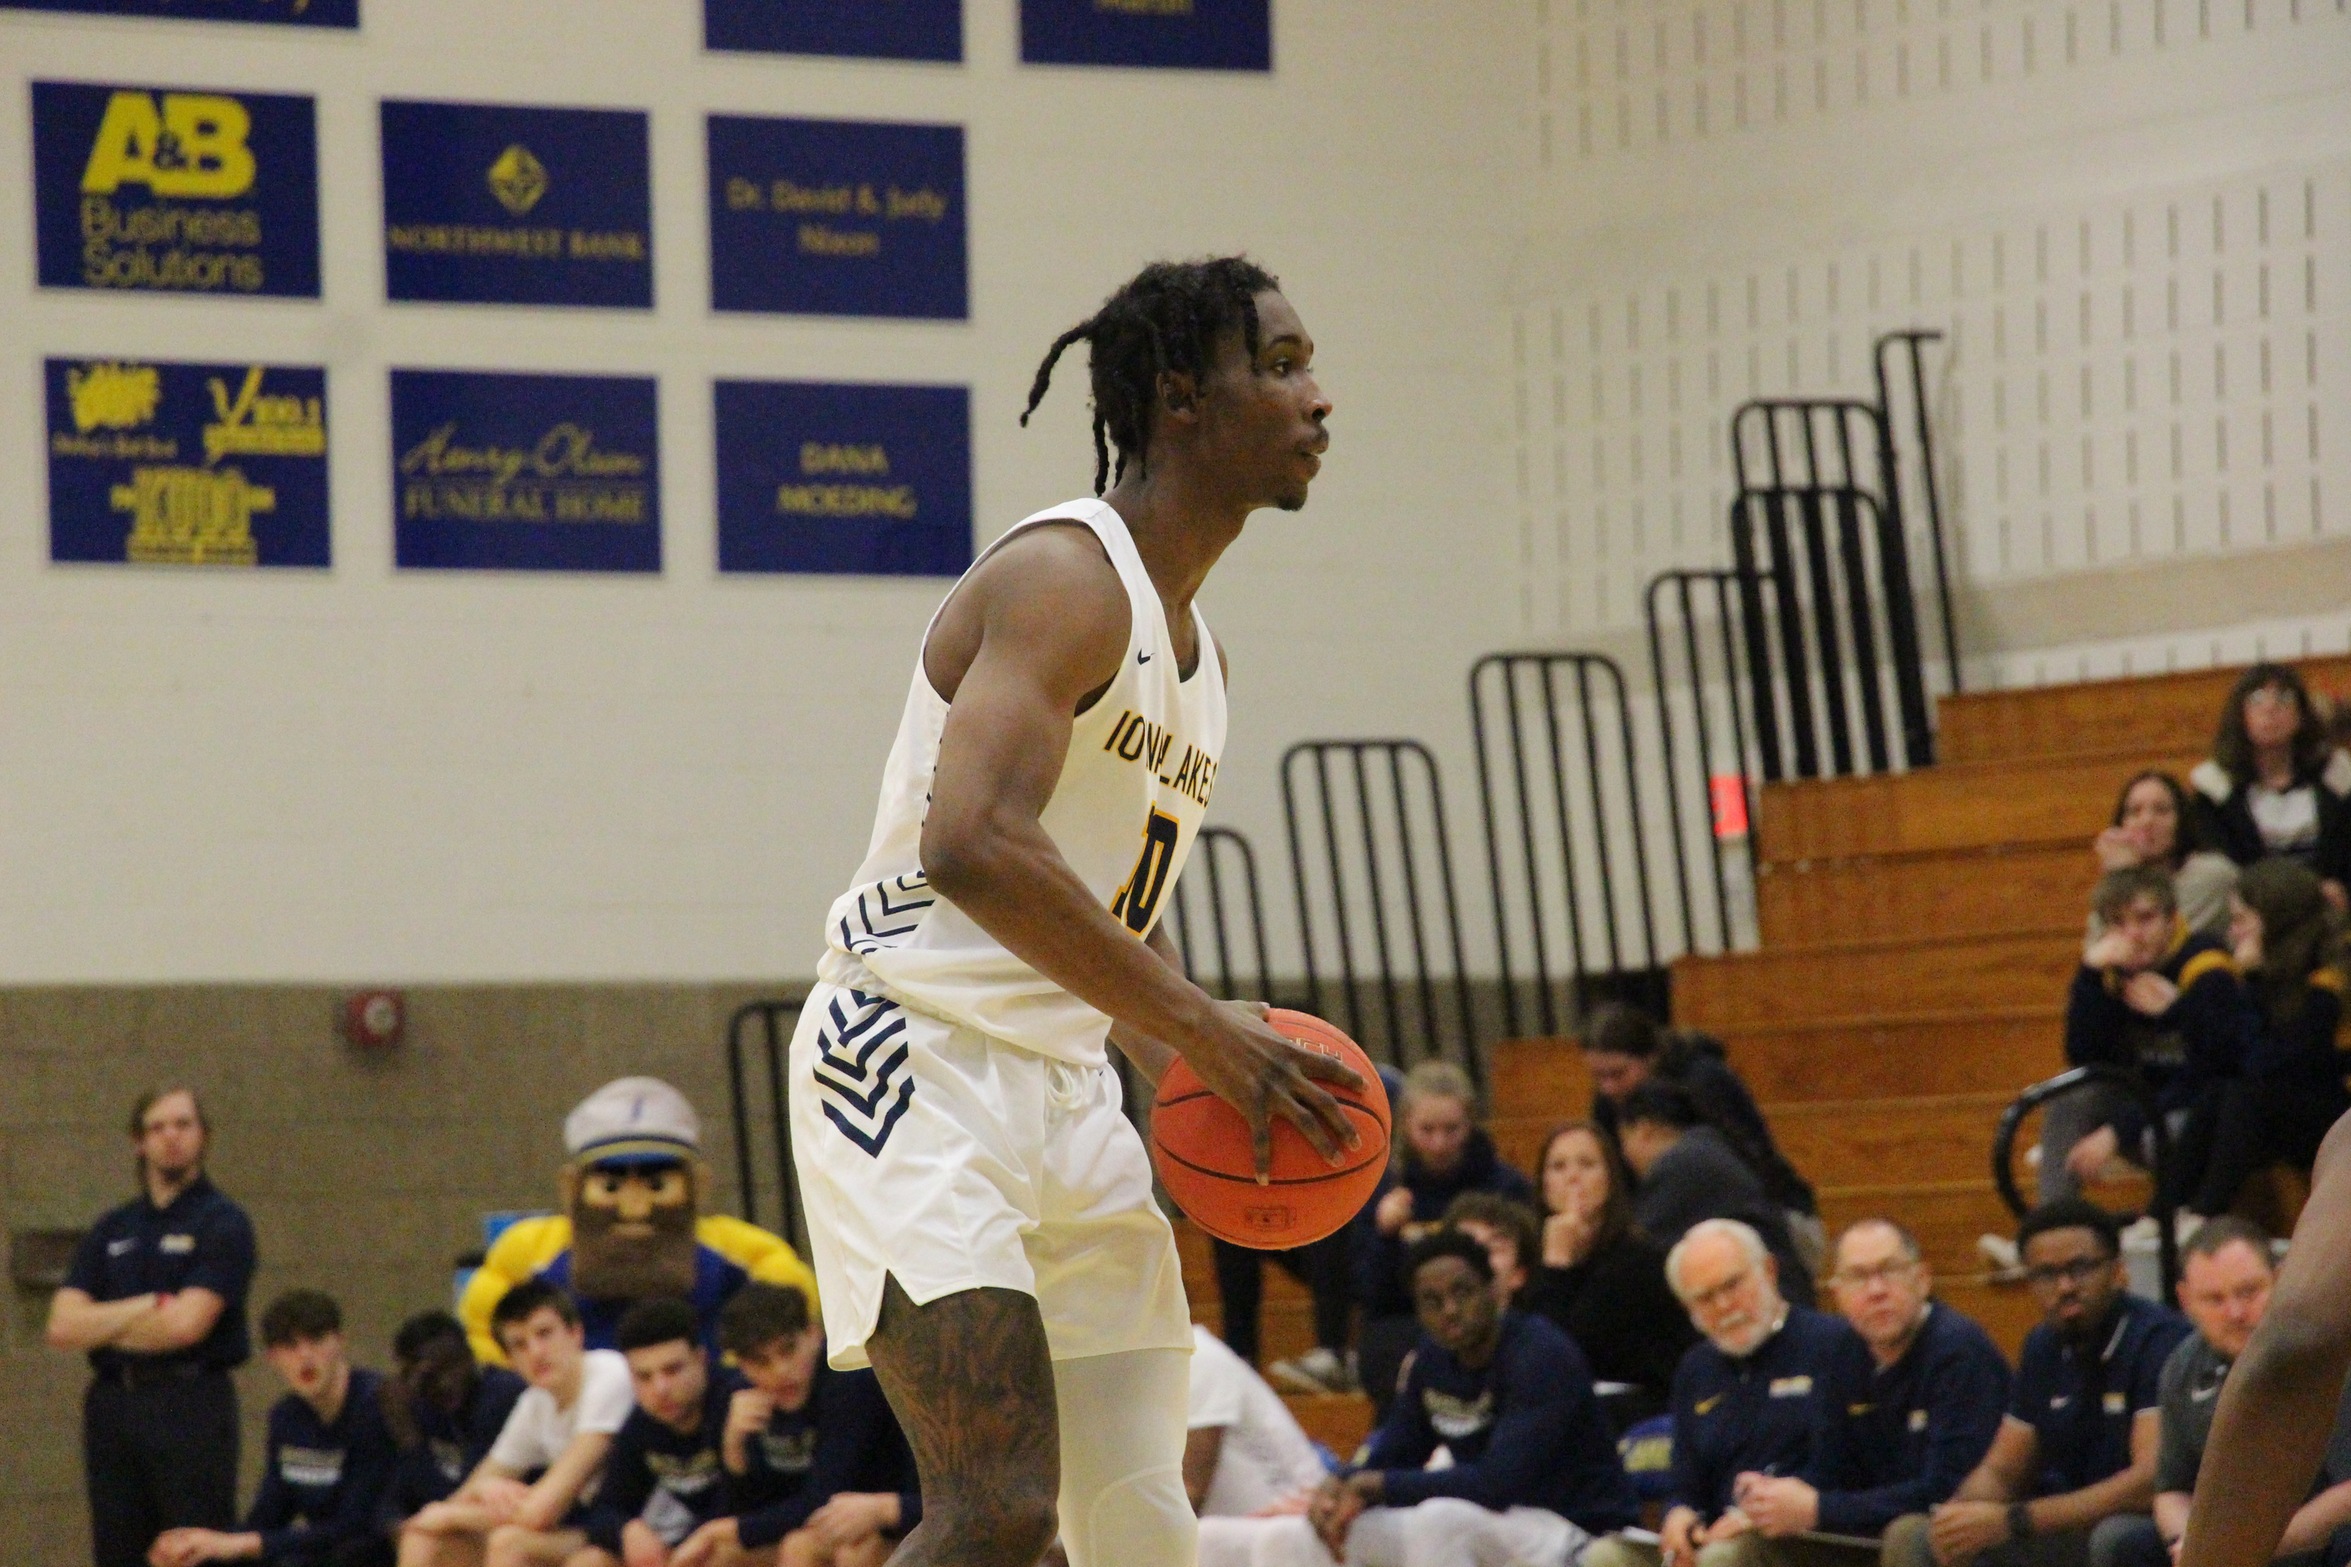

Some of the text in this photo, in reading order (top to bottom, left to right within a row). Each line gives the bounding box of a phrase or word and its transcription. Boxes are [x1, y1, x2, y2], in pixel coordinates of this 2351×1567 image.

[83, 91, 256, 198] A&B
[81, 197, 262, 247] Business
[772, 180, 850, 215] David
[857, 184, 878, 217] &
[886, 186, 947, 222] Judy
[83, 238, 264, 290] Solutions
[568, 229, 643, 260] BANK
[802, 440, 889, 475] DANA
[404, 486, 643, 523] FUNERAL HOME
